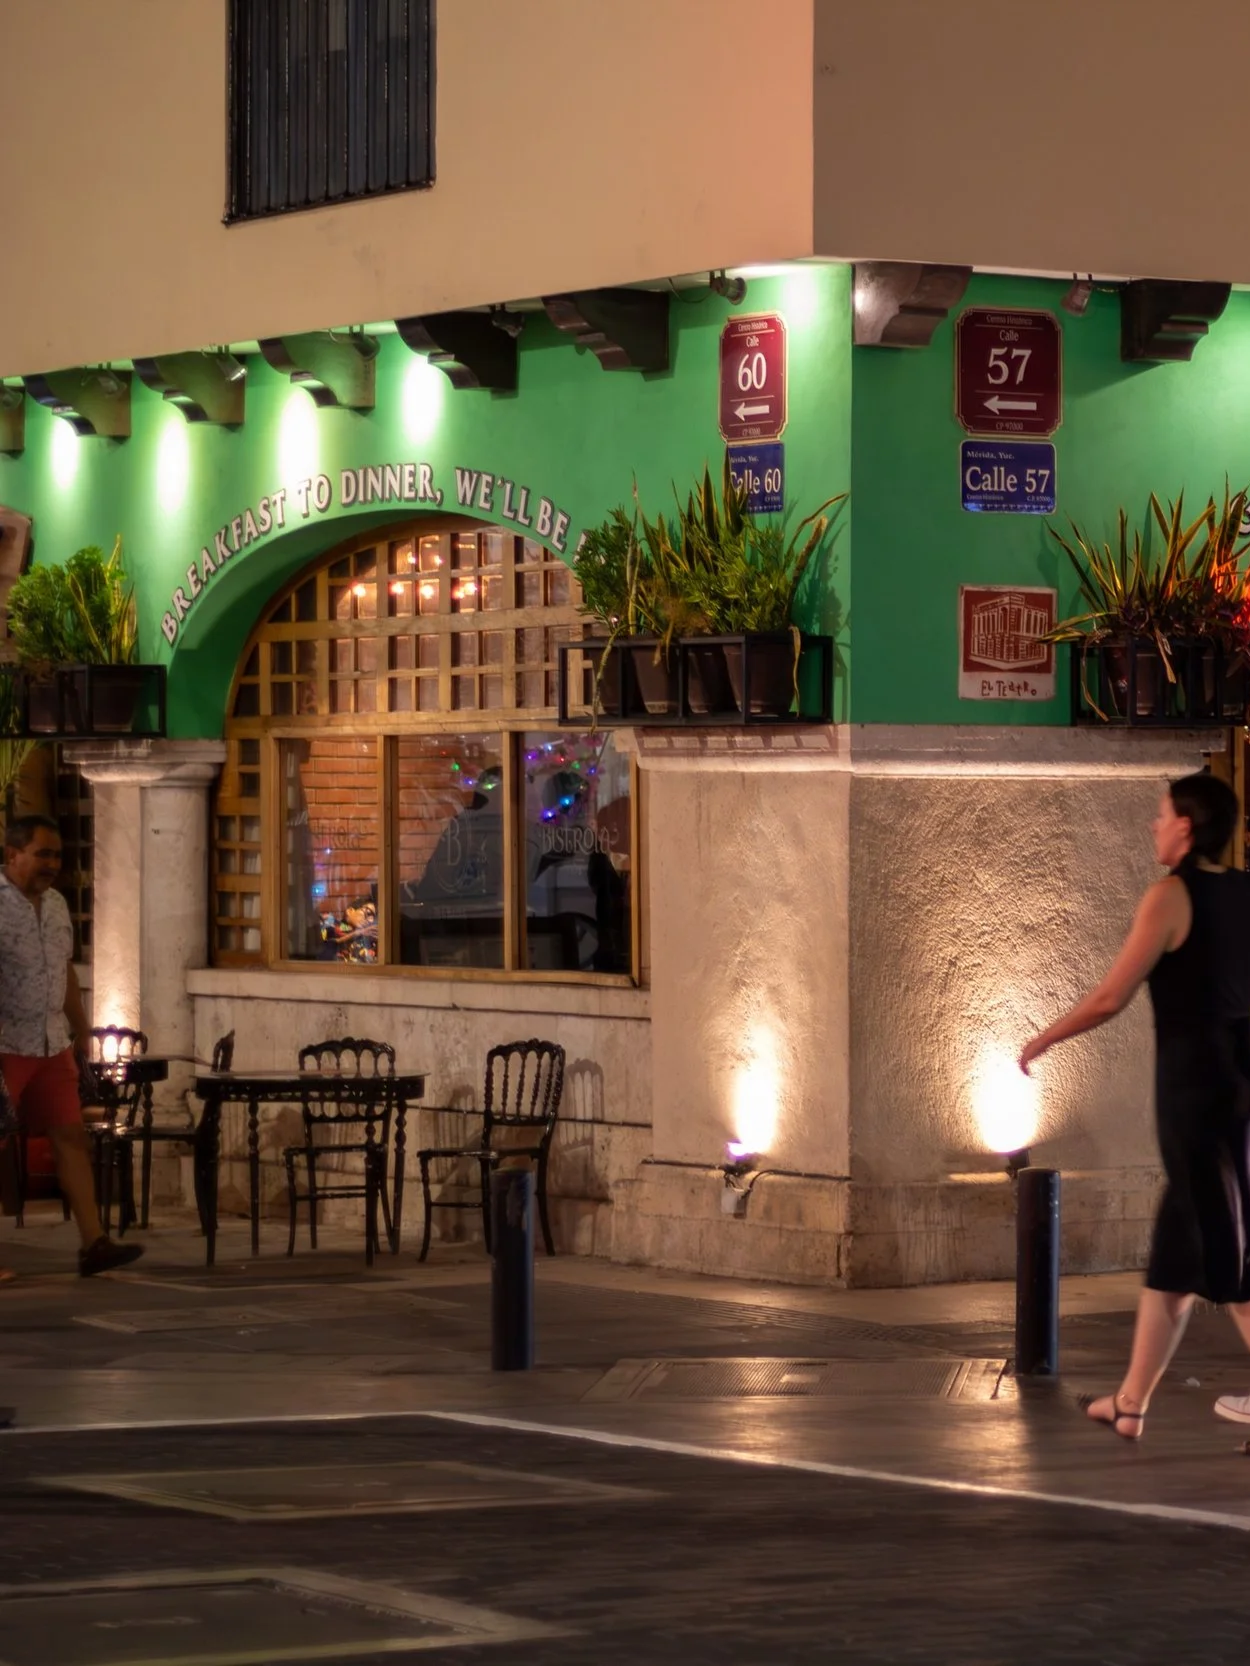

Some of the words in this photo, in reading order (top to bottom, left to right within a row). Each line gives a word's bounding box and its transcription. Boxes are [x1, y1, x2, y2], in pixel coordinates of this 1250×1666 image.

[745, 335, 760, 348] Calle
[999, 329, 1020, 342] Calle
[737, 352, 767, 391] 60
[986, 346, 1032, 385] 57
[966, 450, 997, 460] Mérida,
[764, 468, 781, 494] 60
[965, 465, 1018, 492] Calle
[1024, 468, 1050, 494] 57
[160, 487, 286, 645] BREAKFAST
[298, 474, 331, 517] TO
[341, 463, 443, 507] DINNER,
[456, 466, 532, 527] WE'LL
[536, 496, 571, 554] BE
